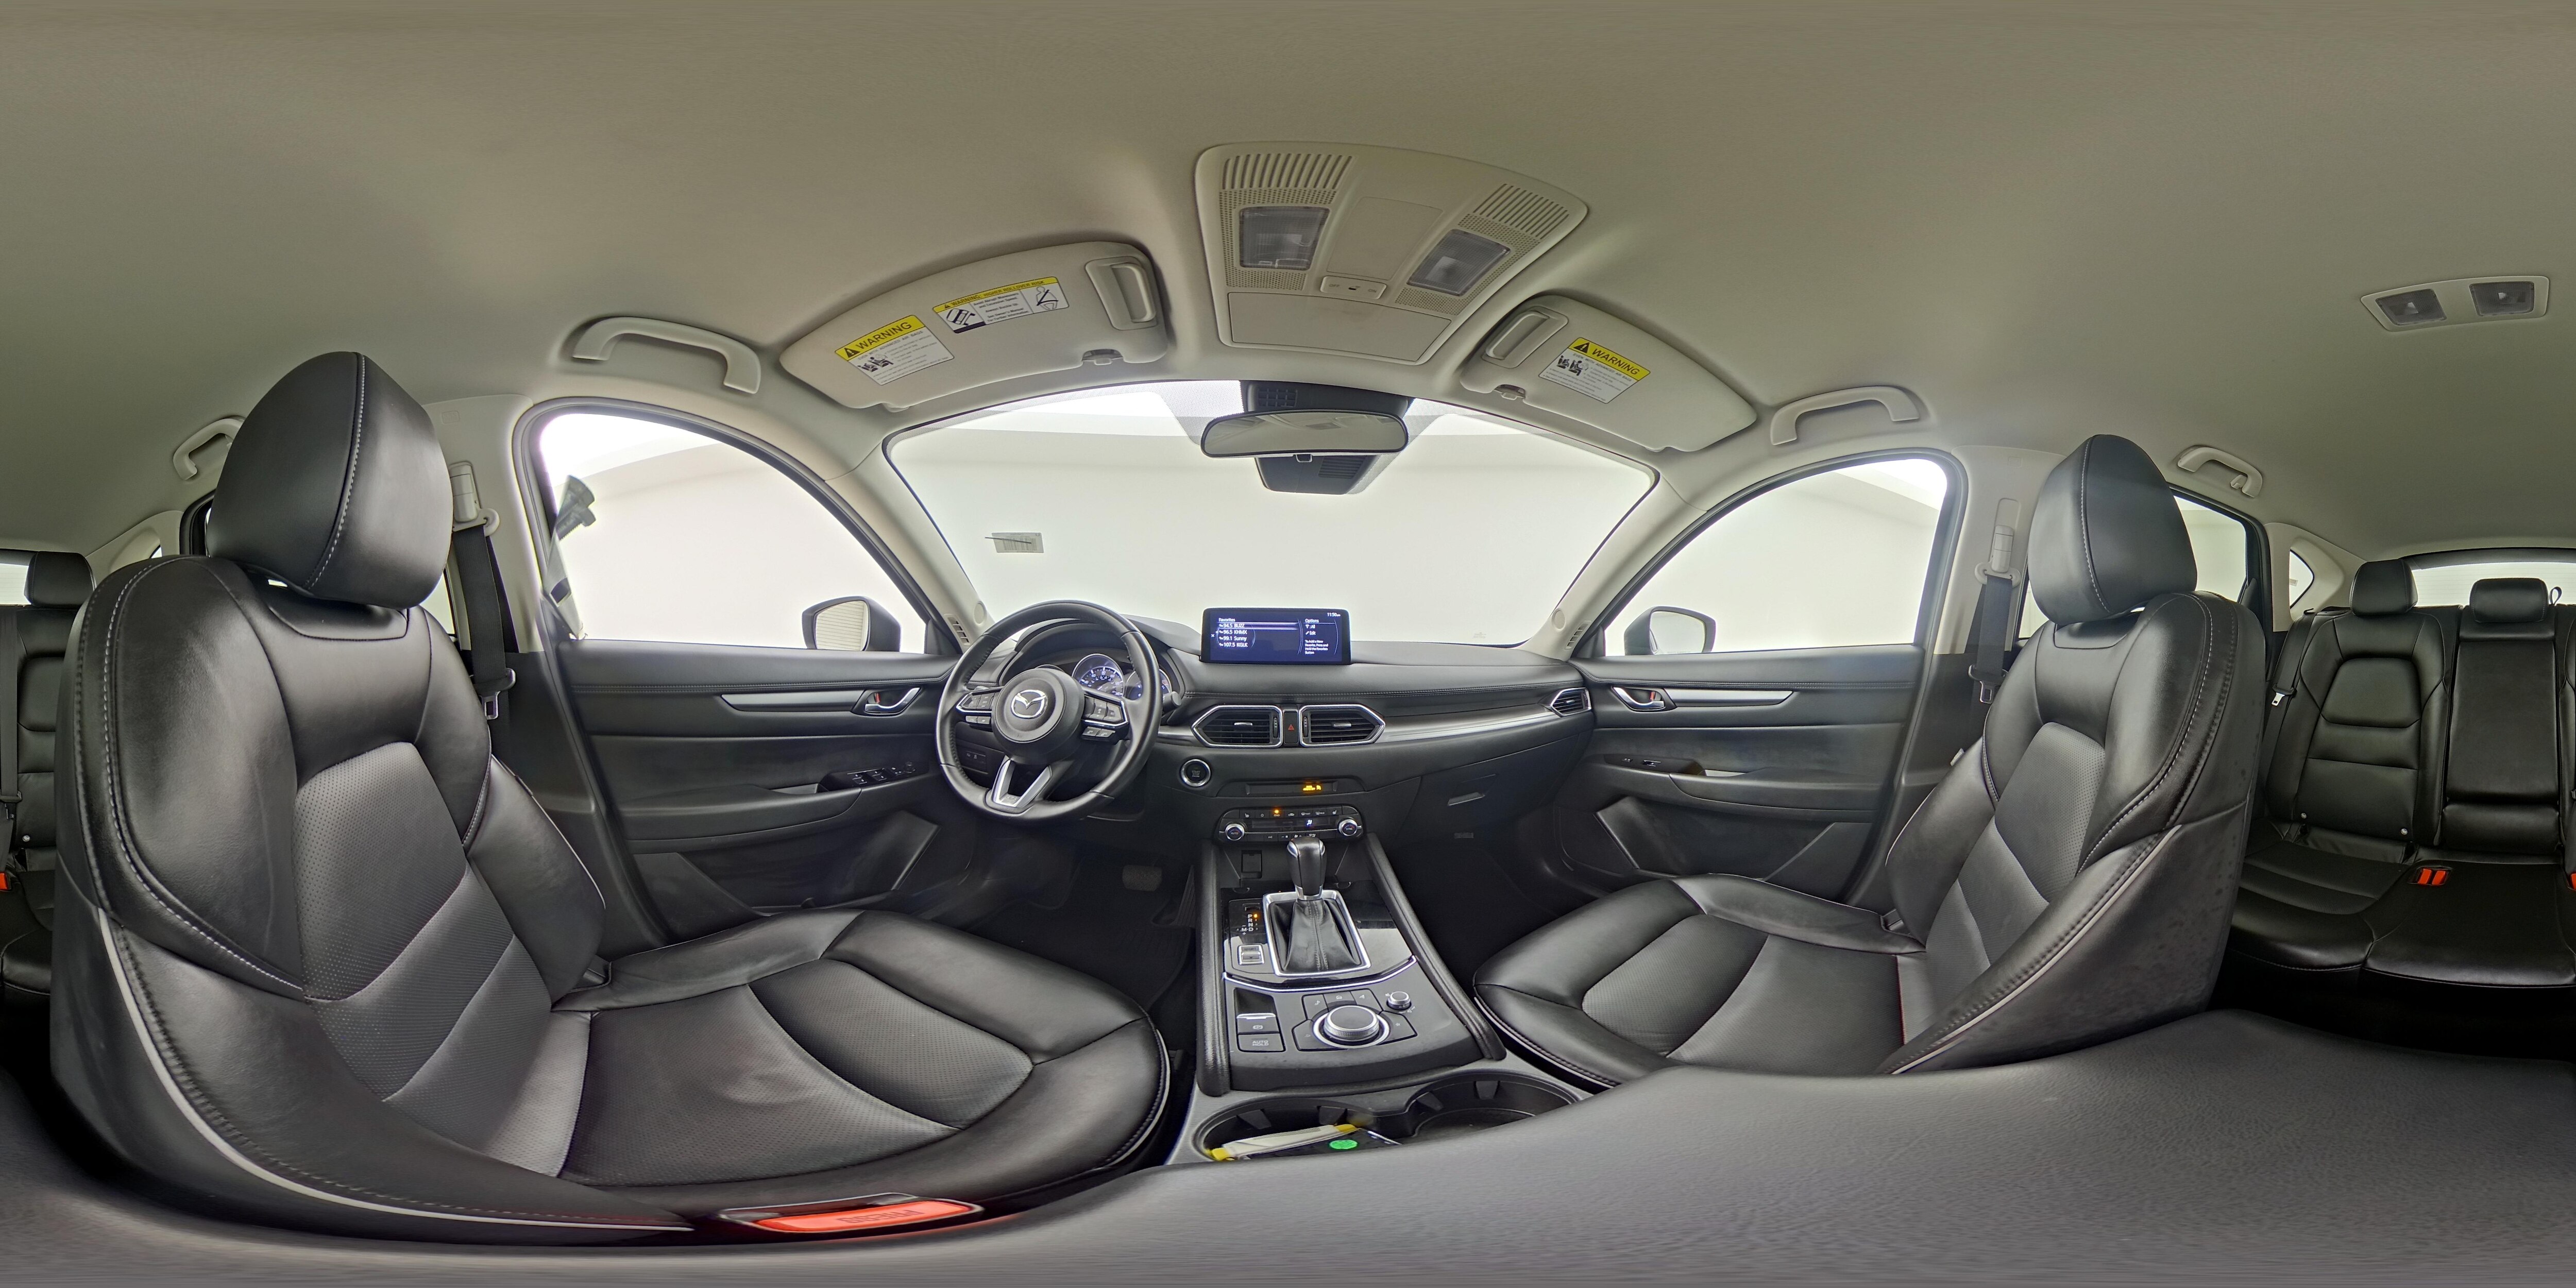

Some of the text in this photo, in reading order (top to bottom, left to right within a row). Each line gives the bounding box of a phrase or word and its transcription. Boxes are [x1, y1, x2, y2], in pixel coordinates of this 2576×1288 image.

[1004, 283, 1031, 292] ROLLOVER
[856, 321, 912, 349] WARNING
[1591, 348, 1640, 375] WARNING
[836, 1210, 925, 1223] PRESS
